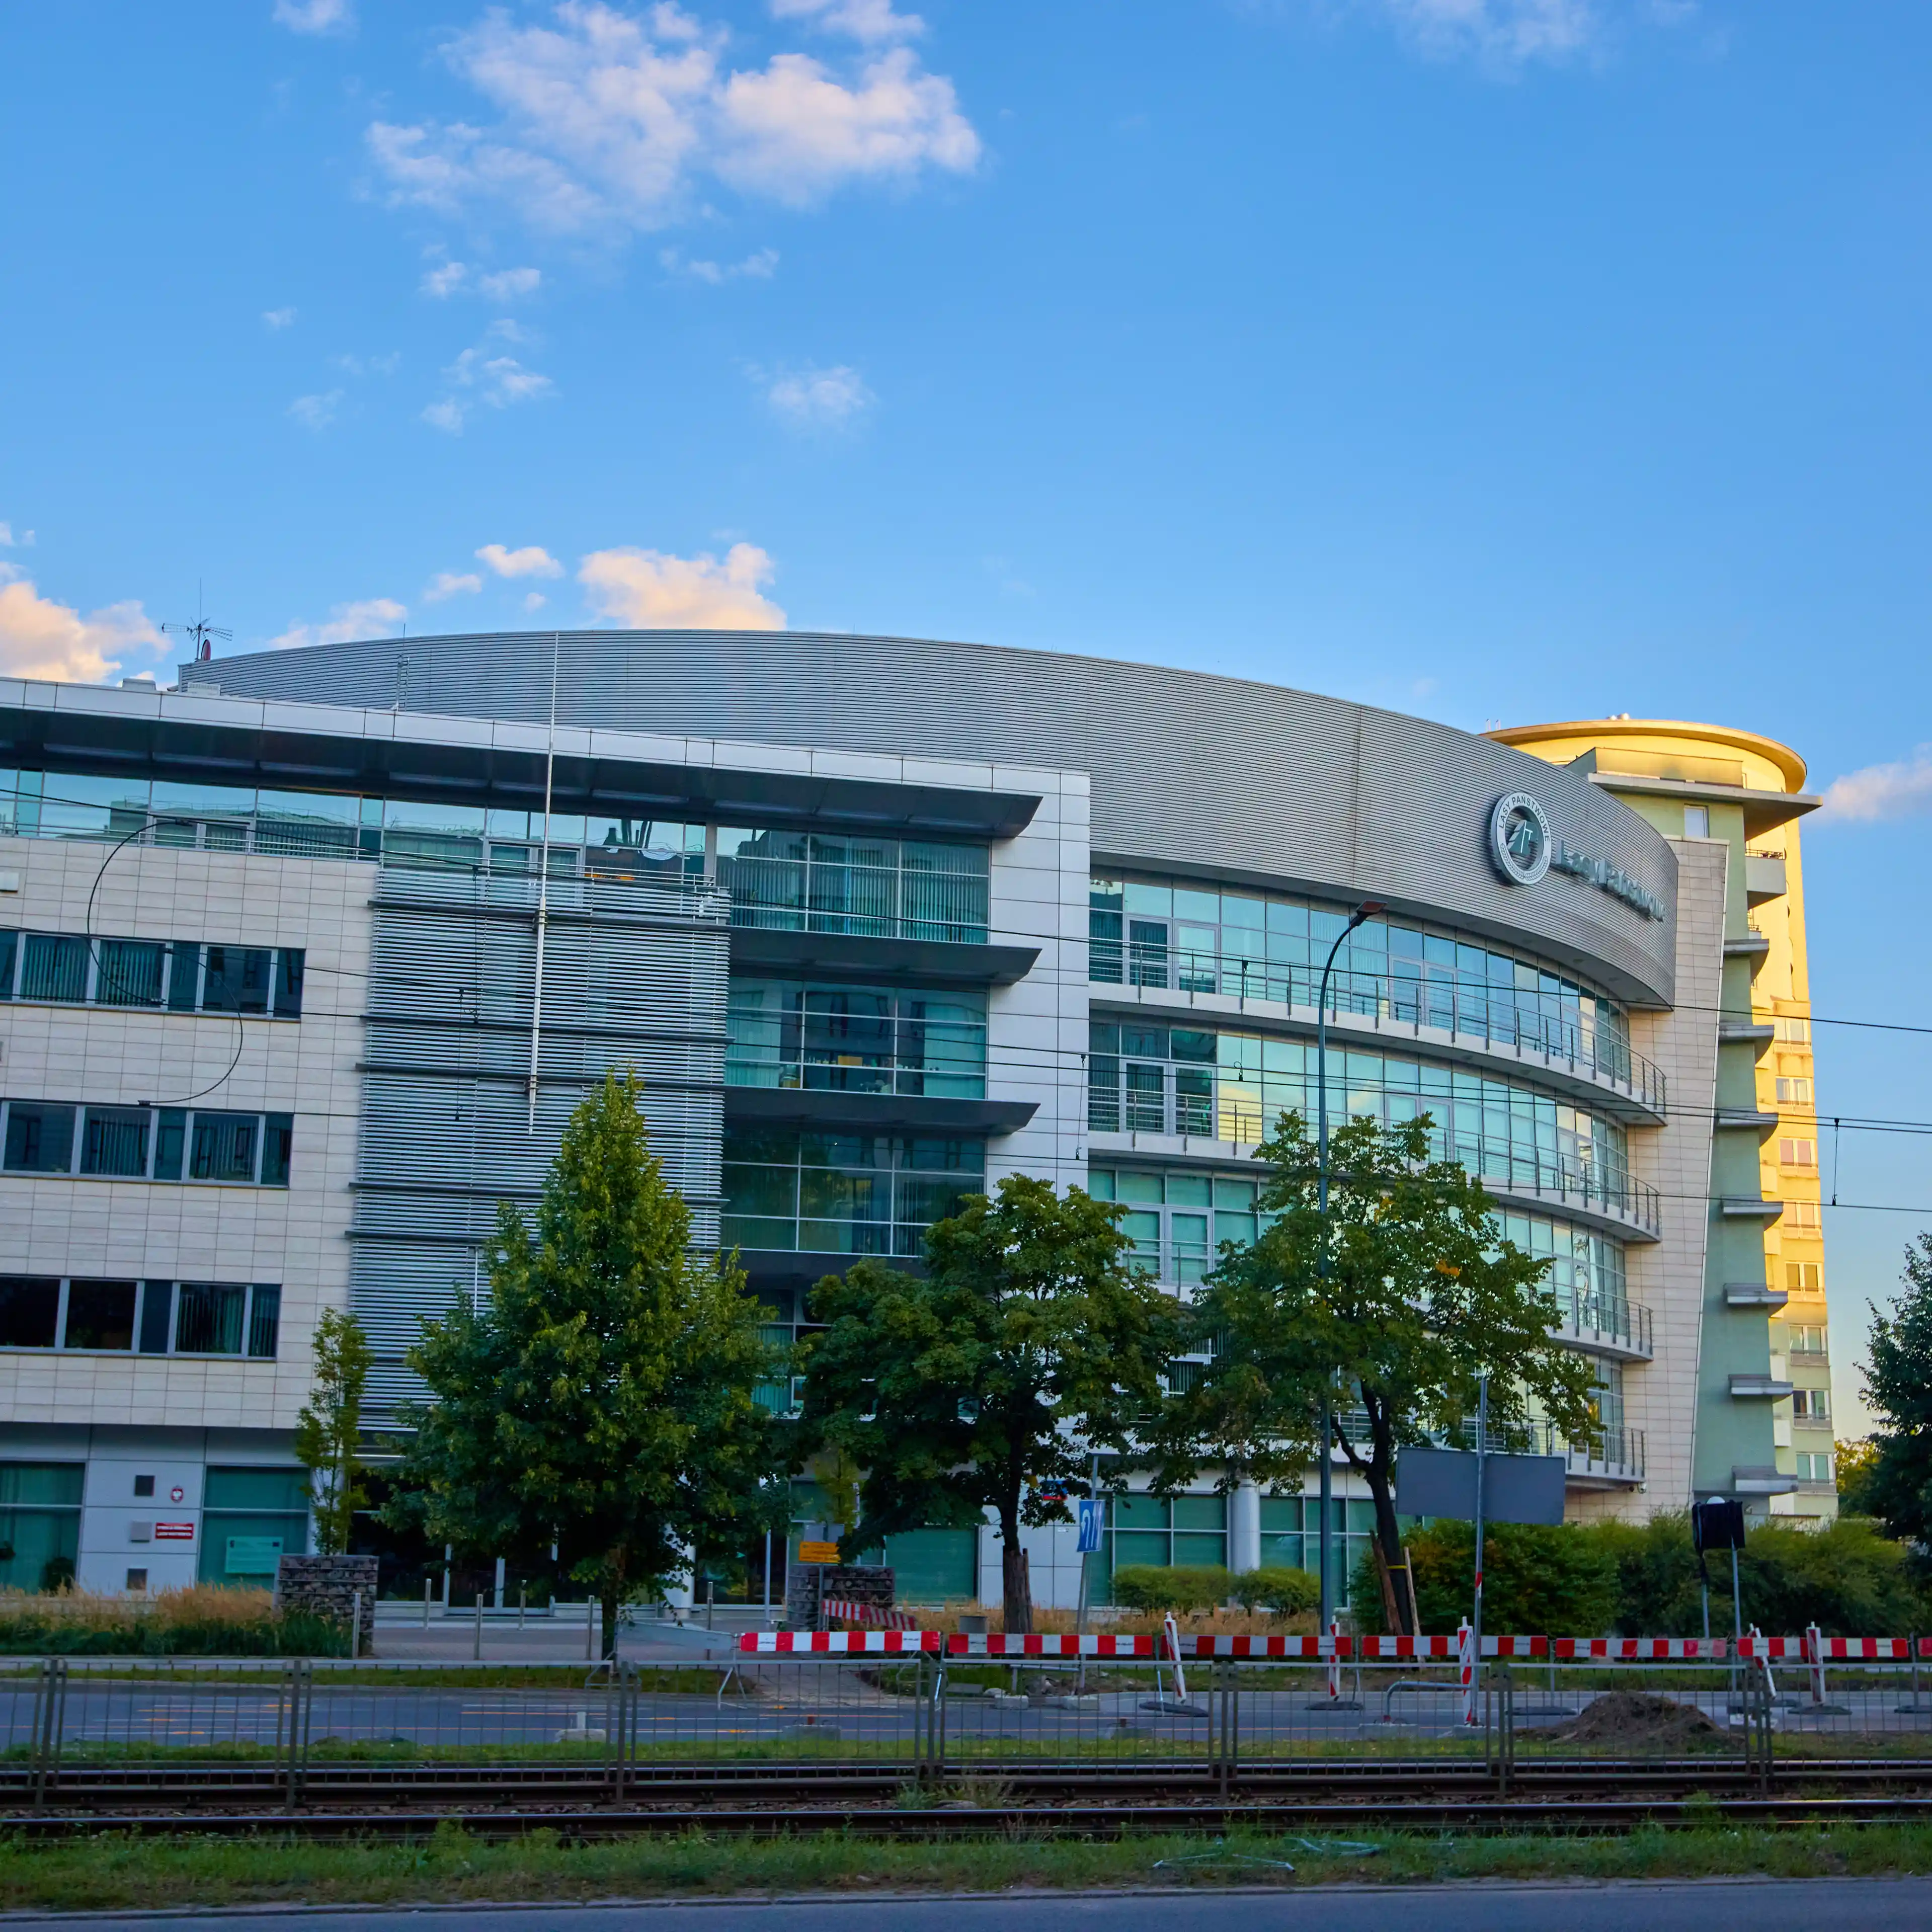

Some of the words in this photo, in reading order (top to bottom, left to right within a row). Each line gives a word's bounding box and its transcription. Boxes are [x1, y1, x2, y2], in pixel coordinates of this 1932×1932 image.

[1499, 801, 1511, 829] LASY
[1511, 794, 1550, 842] PAŃSTWOWE
[1556, 839, 1599, 885] Lasy
